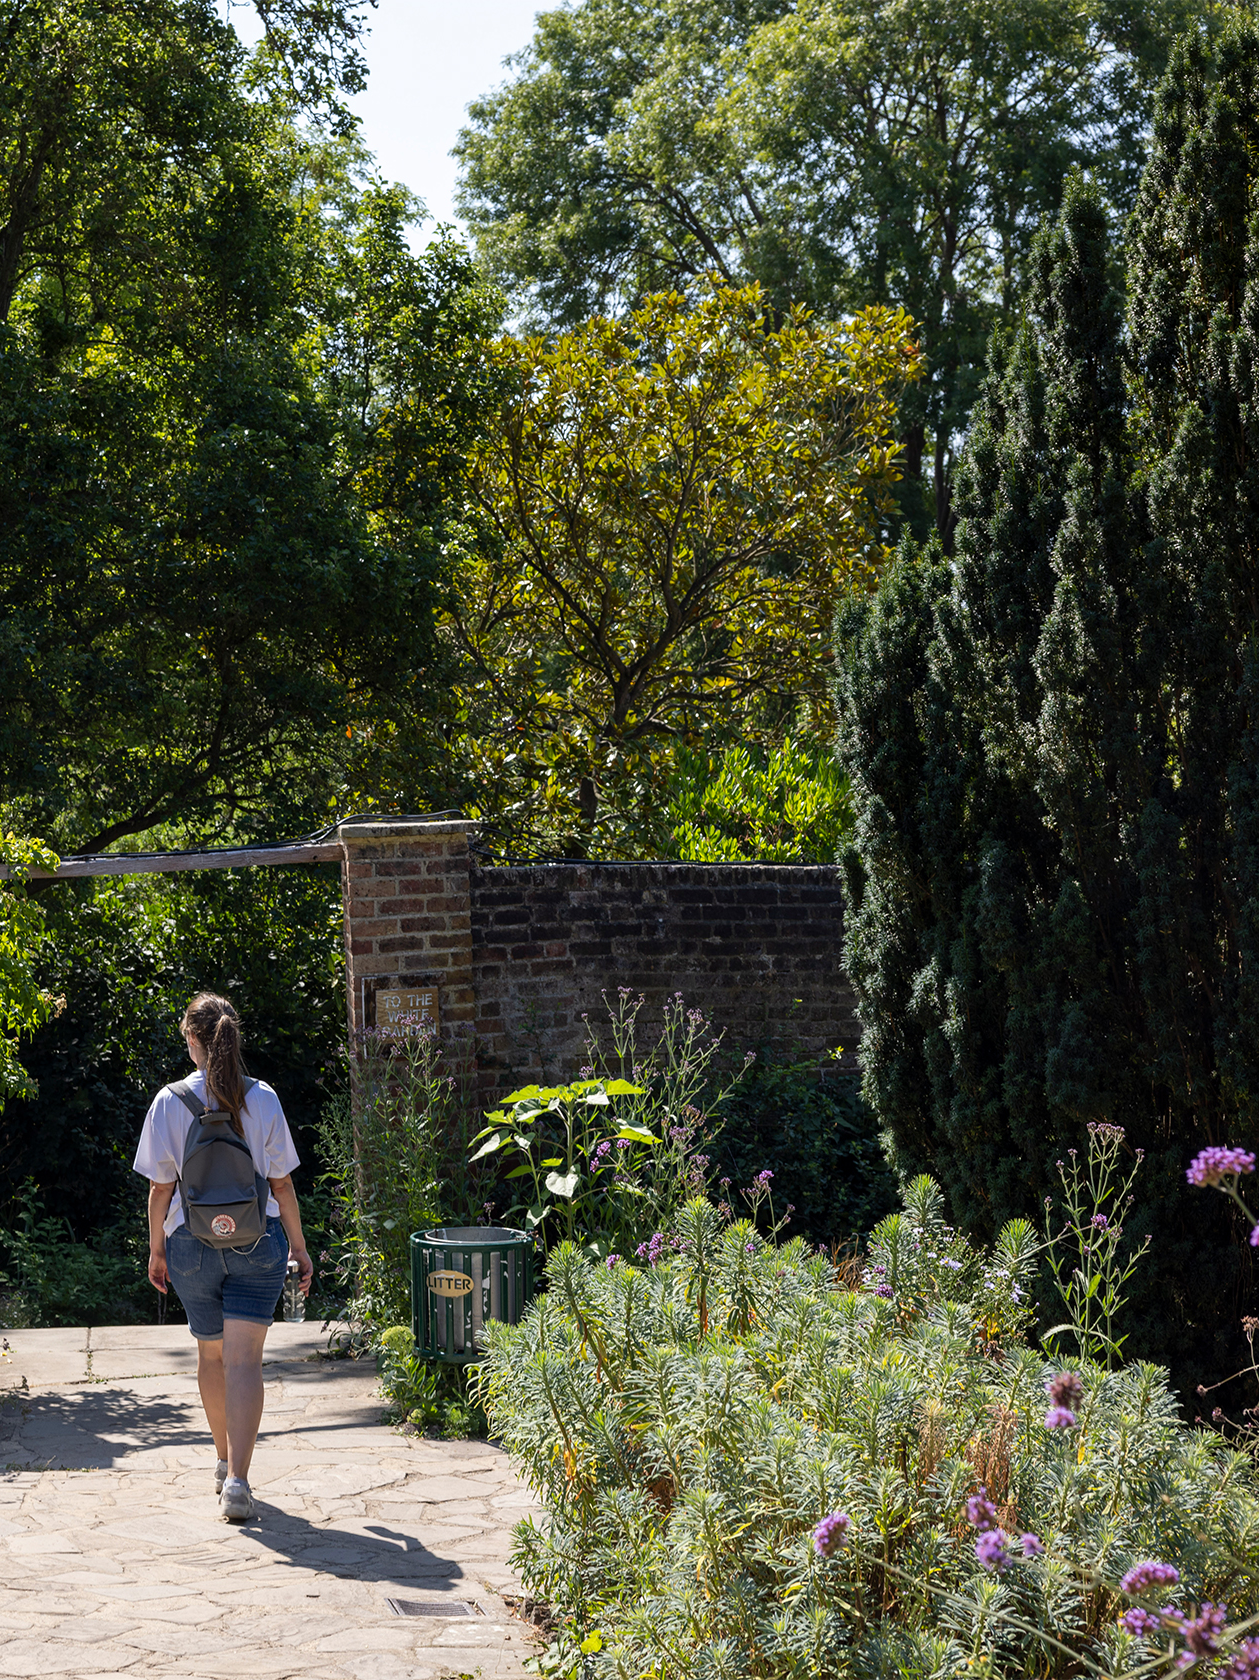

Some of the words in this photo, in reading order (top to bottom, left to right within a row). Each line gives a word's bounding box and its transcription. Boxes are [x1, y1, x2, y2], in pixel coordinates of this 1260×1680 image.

[383, 996, 401, 1008] TO
[407, 994, 432, 1006] THE
[428, 1276, 471, 1290] LITTER
